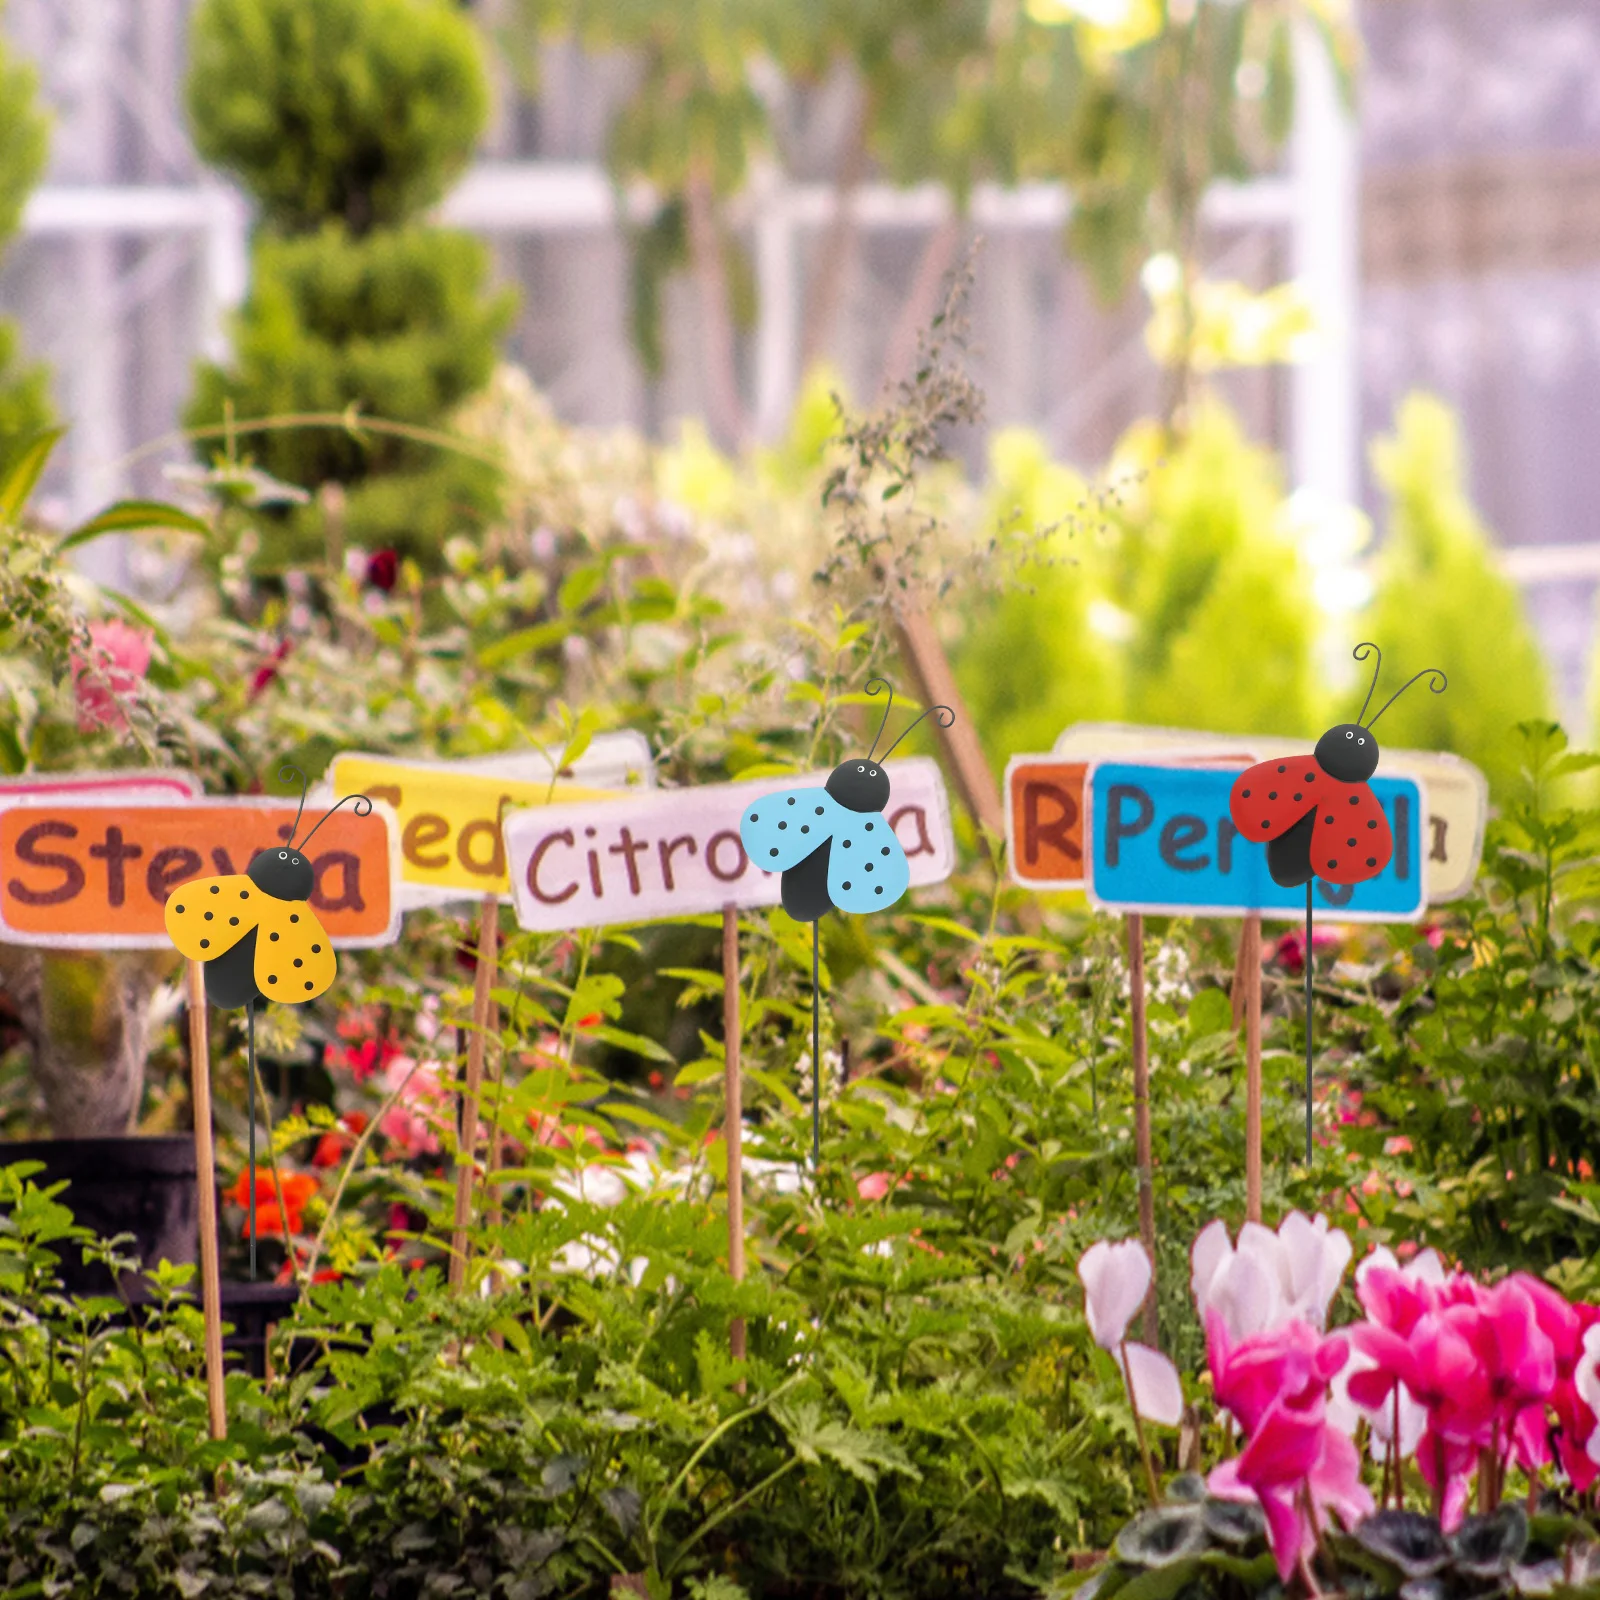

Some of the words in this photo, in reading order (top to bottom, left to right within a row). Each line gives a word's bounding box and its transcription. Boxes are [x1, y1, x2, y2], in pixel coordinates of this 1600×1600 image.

[7, 820, 366, 913] Stea
[526, 804, 936, 905] Citroa
[1105, 783, 1410, 906] Perl
